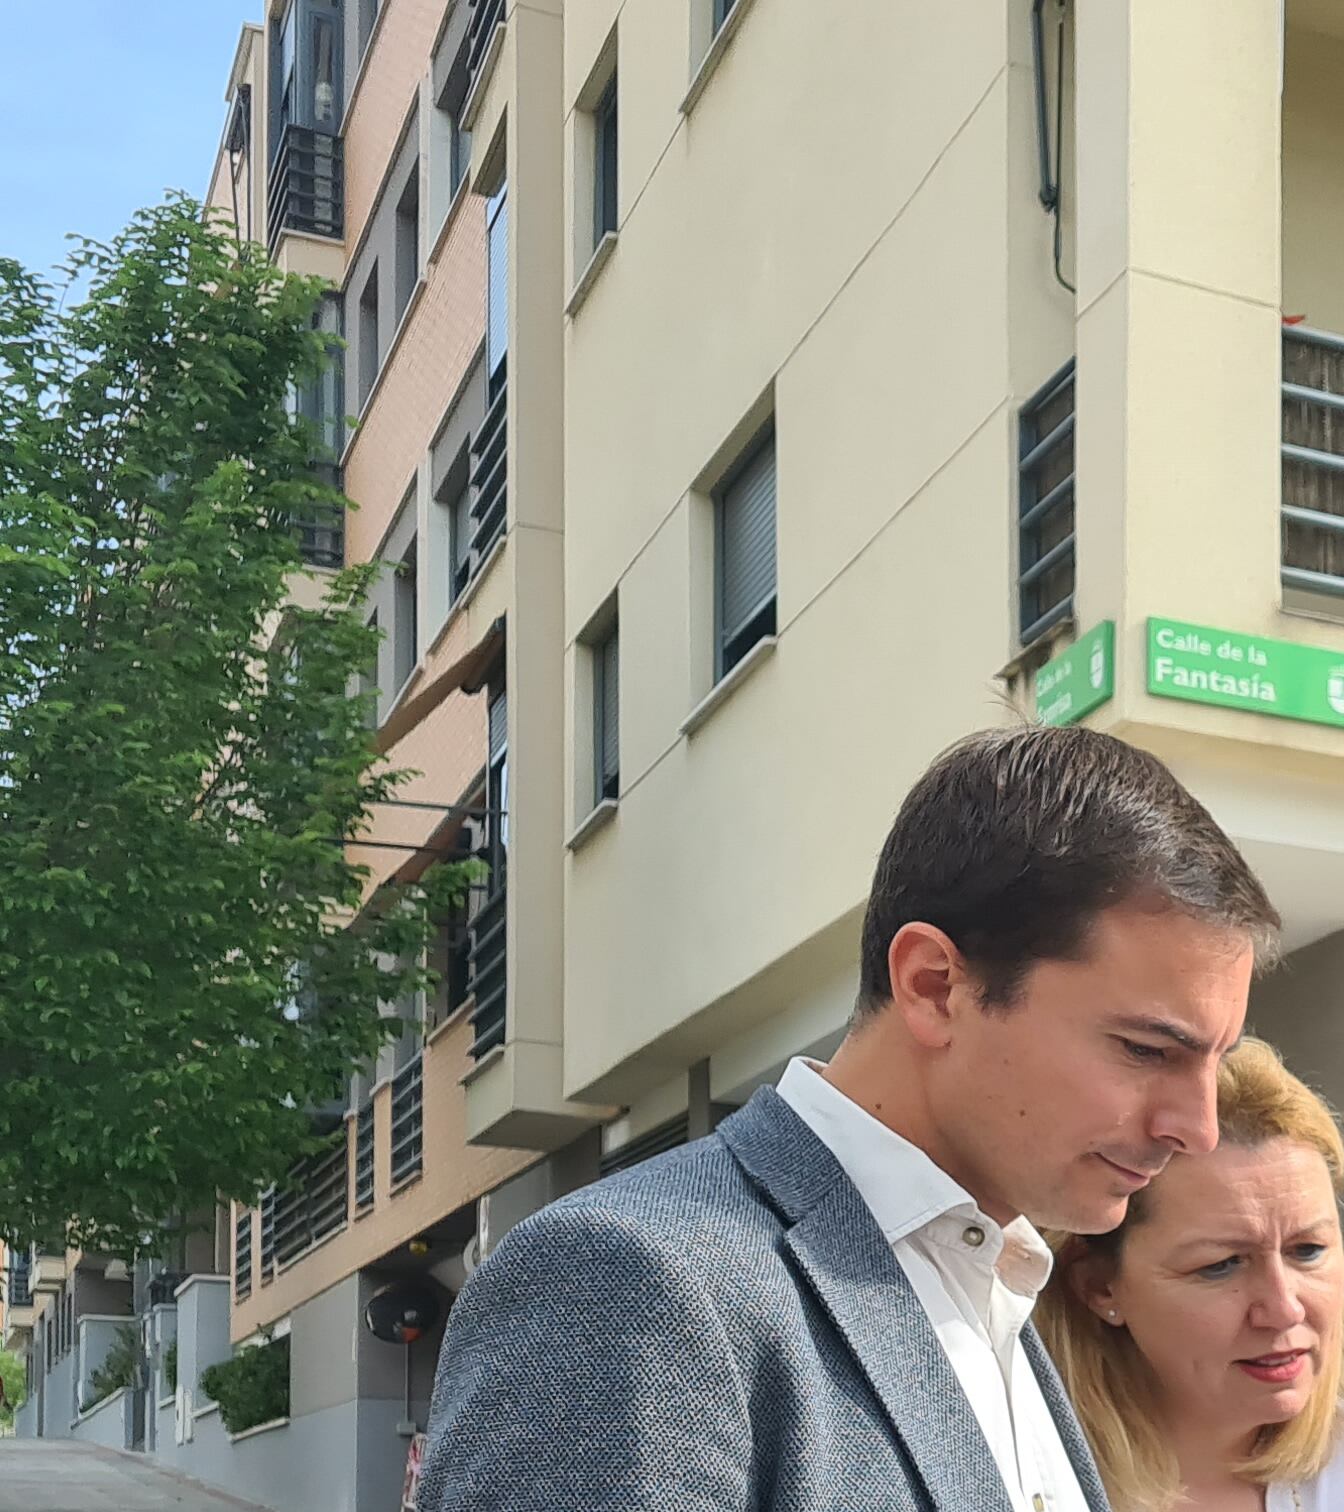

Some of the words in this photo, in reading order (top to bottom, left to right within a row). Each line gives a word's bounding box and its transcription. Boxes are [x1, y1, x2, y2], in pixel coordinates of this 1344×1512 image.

[1156, 628, 1212, 656] Calle
[1216, 640, 1243, 662] de
[1247, 644, 1268, 666] la
[1155, 656, 1276, 702] Fantasía
